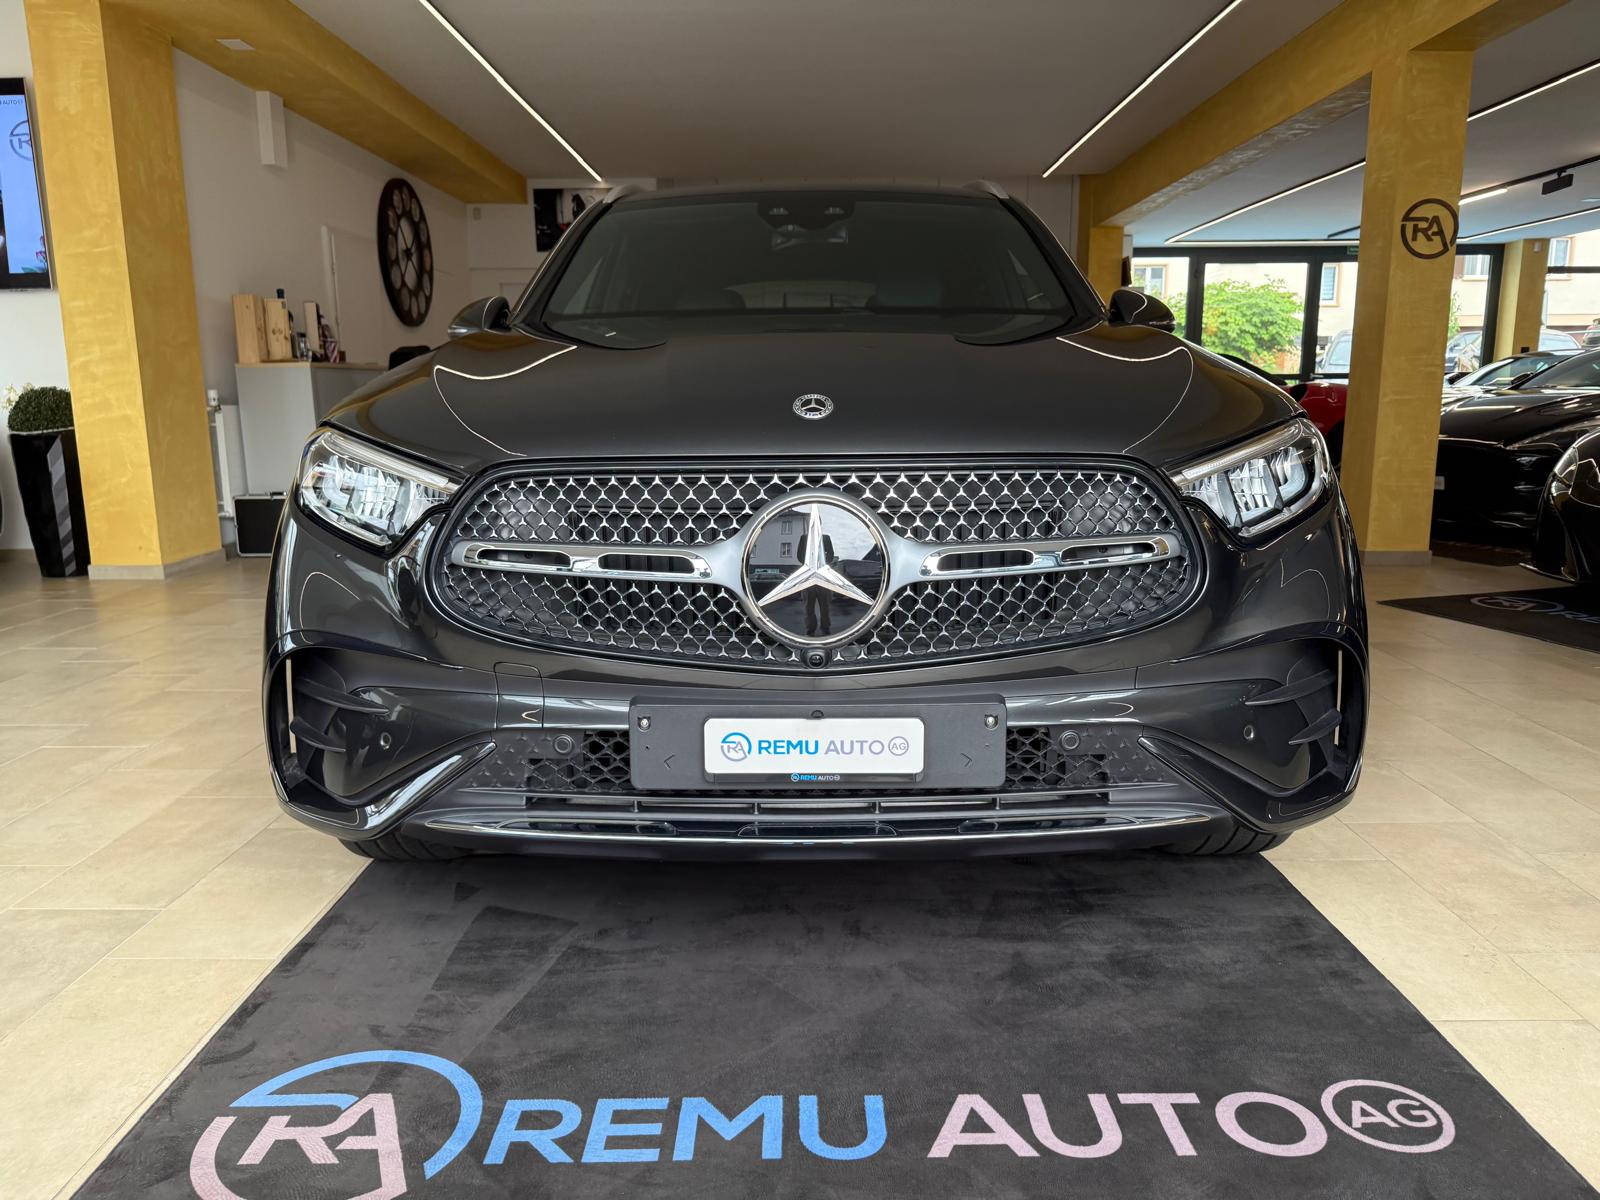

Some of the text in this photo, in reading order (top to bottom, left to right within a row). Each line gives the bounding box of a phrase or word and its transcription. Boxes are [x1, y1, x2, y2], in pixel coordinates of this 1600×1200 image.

[757, 739, 819, 755] REMU
[824, 739, 885, 755] AUTO
[483, 1094, 888, 1165] REMU
[926, 1091, 1329, 1159] AUTO
[1351, 1098, 1438, 1129] AG
